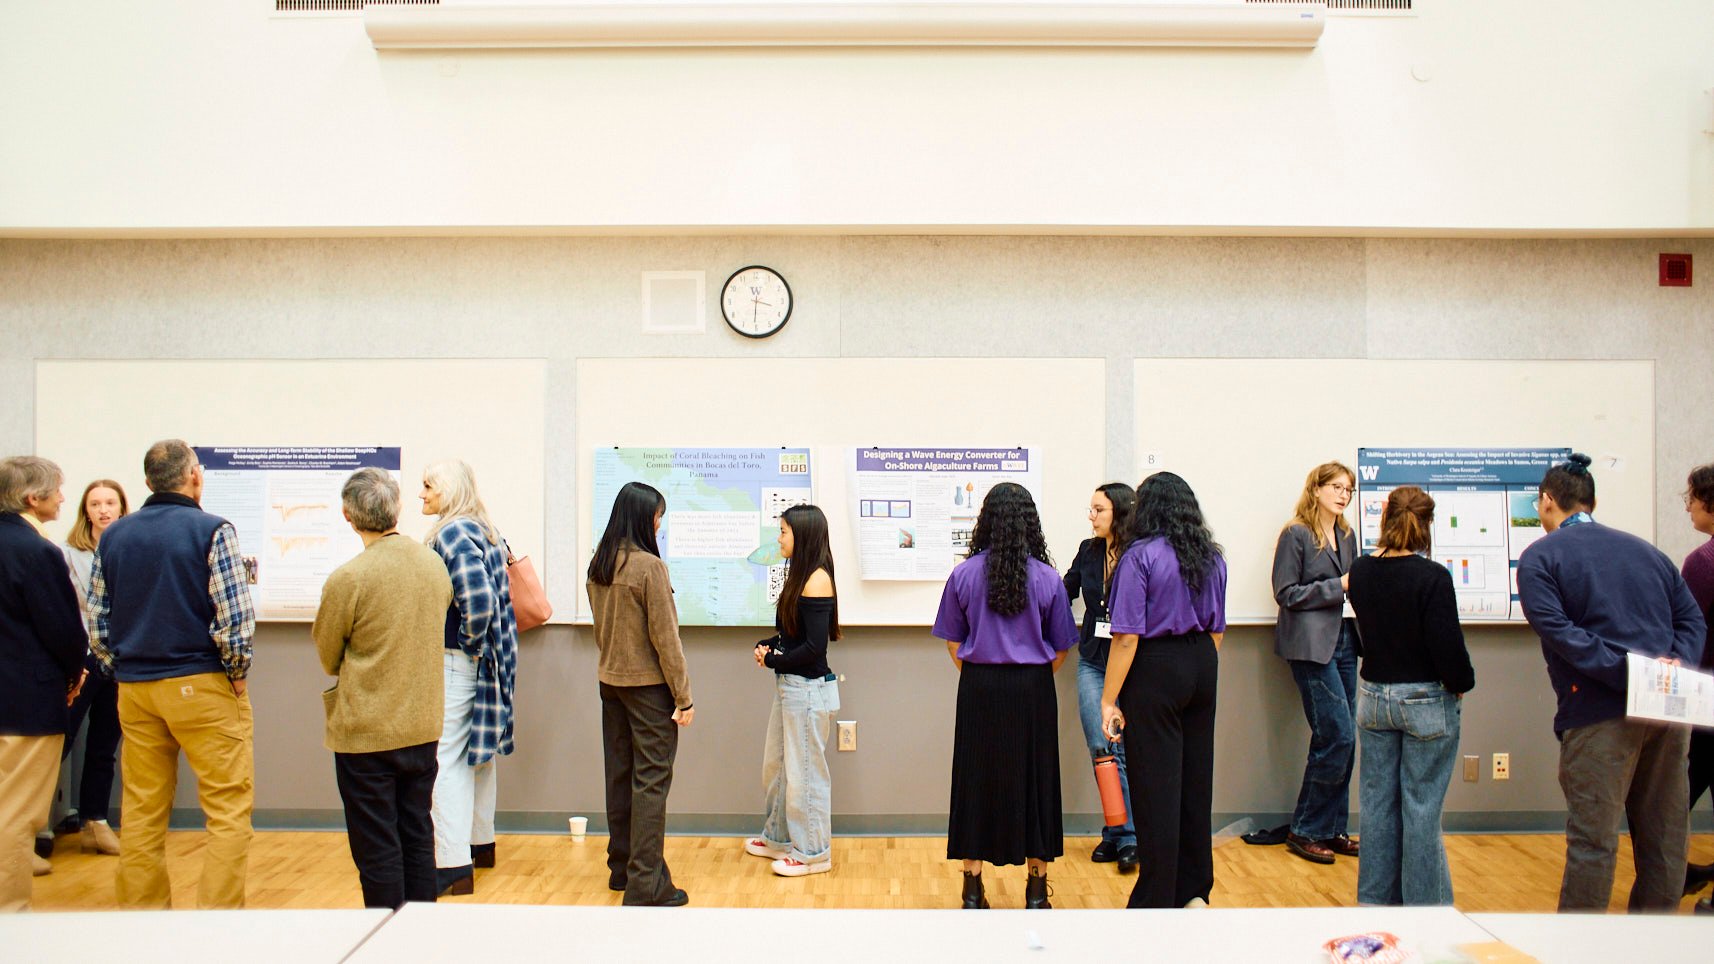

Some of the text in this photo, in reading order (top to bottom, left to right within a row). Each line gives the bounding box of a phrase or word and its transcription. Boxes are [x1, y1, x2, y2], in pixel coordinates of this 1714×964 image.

[750, 286, 762, 296] W
[643, 453, 672, 461] Impact
[702, 453, 736, 461] Bleaching
[864, 451, 903, 460] Designing
[936, 451, 963, 460] Energy
[1149, 454, 1155, 464] 8
[925, 462, 971, 471] Algaculture
[1359, 466, 1379, 480] W
